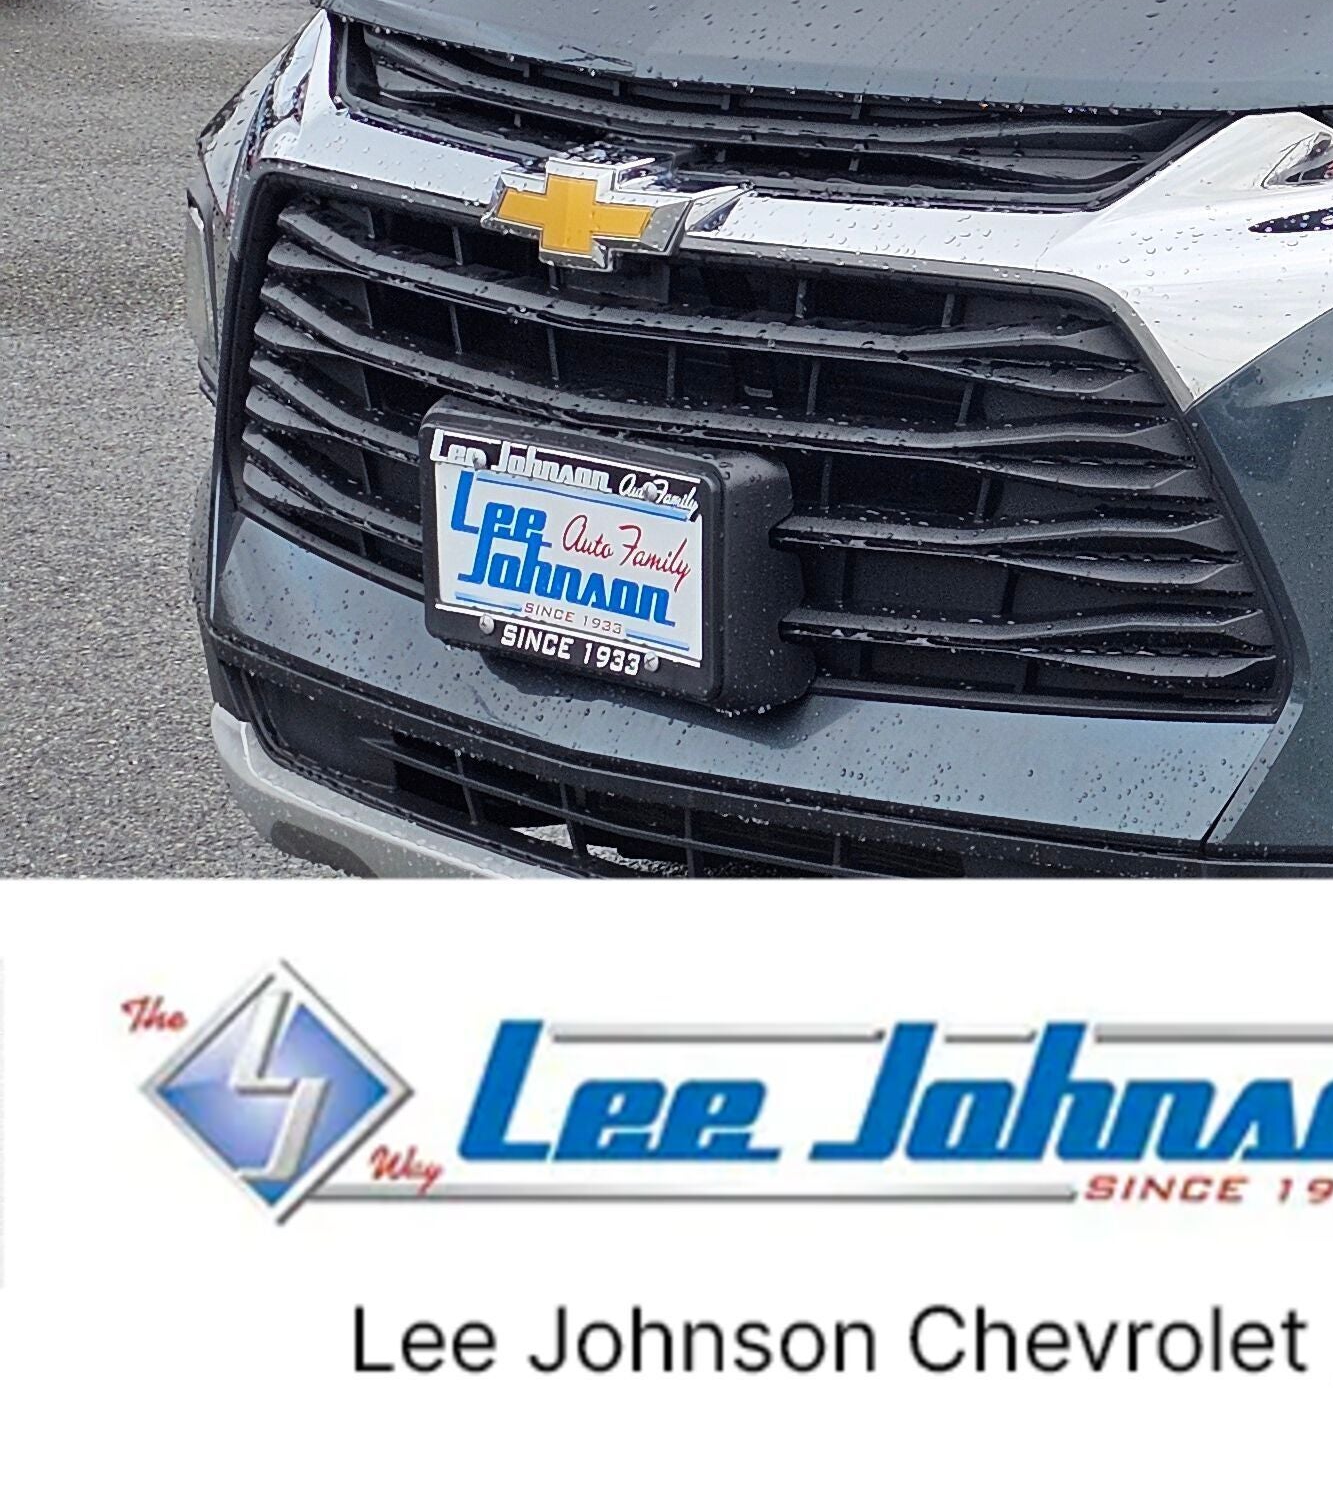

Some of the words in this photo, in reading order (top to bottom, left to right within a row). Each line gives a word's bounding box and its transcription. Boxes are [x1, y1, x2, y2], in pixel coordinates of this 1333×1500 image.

[490, 440, 613, 494] Johnson
[653, 478, 699, 520] Family
[450, 470, 552, 547] Lee
[562, 514, 614, 560] Auto
[618, 524, 692, 593] Family
[457, 503, 676, 627] Johnson
[500, 624, 575, 660] SINCE
[583, 642, 641, 676] 1933
[524, 602, 576, 623] SINCE
[583, 615, 622, 635] 1933
